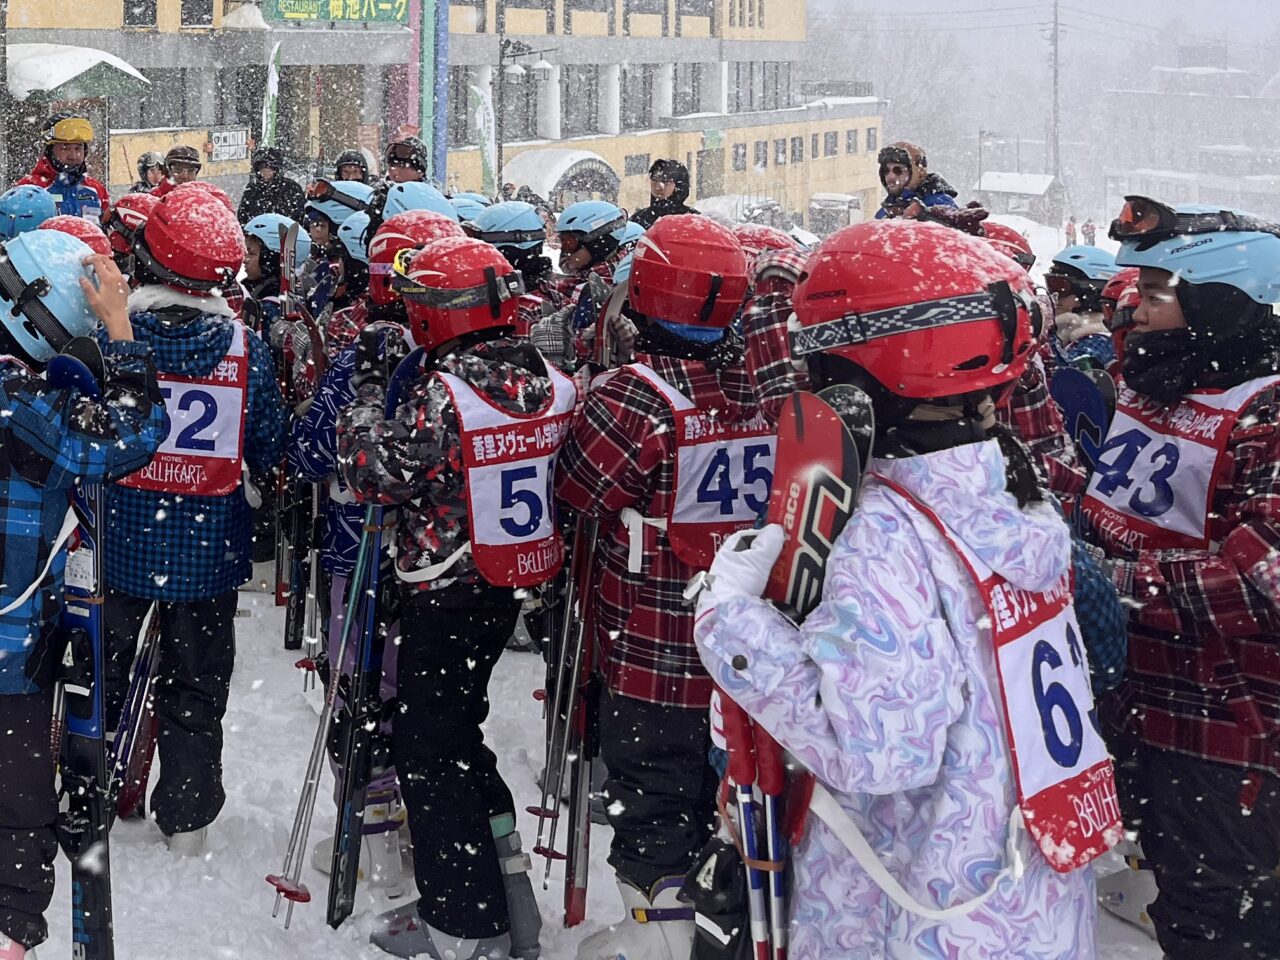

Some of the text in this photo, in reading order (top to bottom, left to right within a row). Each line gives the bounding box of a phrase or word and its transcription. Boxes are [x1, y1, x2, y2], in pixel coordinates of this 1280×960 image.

[278, 0, 320, 12] RESTAURANT
[141, 461, 203, 484] BELLHEART
[697, 443, 773, 515] 45
[1095, 428, 1180, 517] 43
